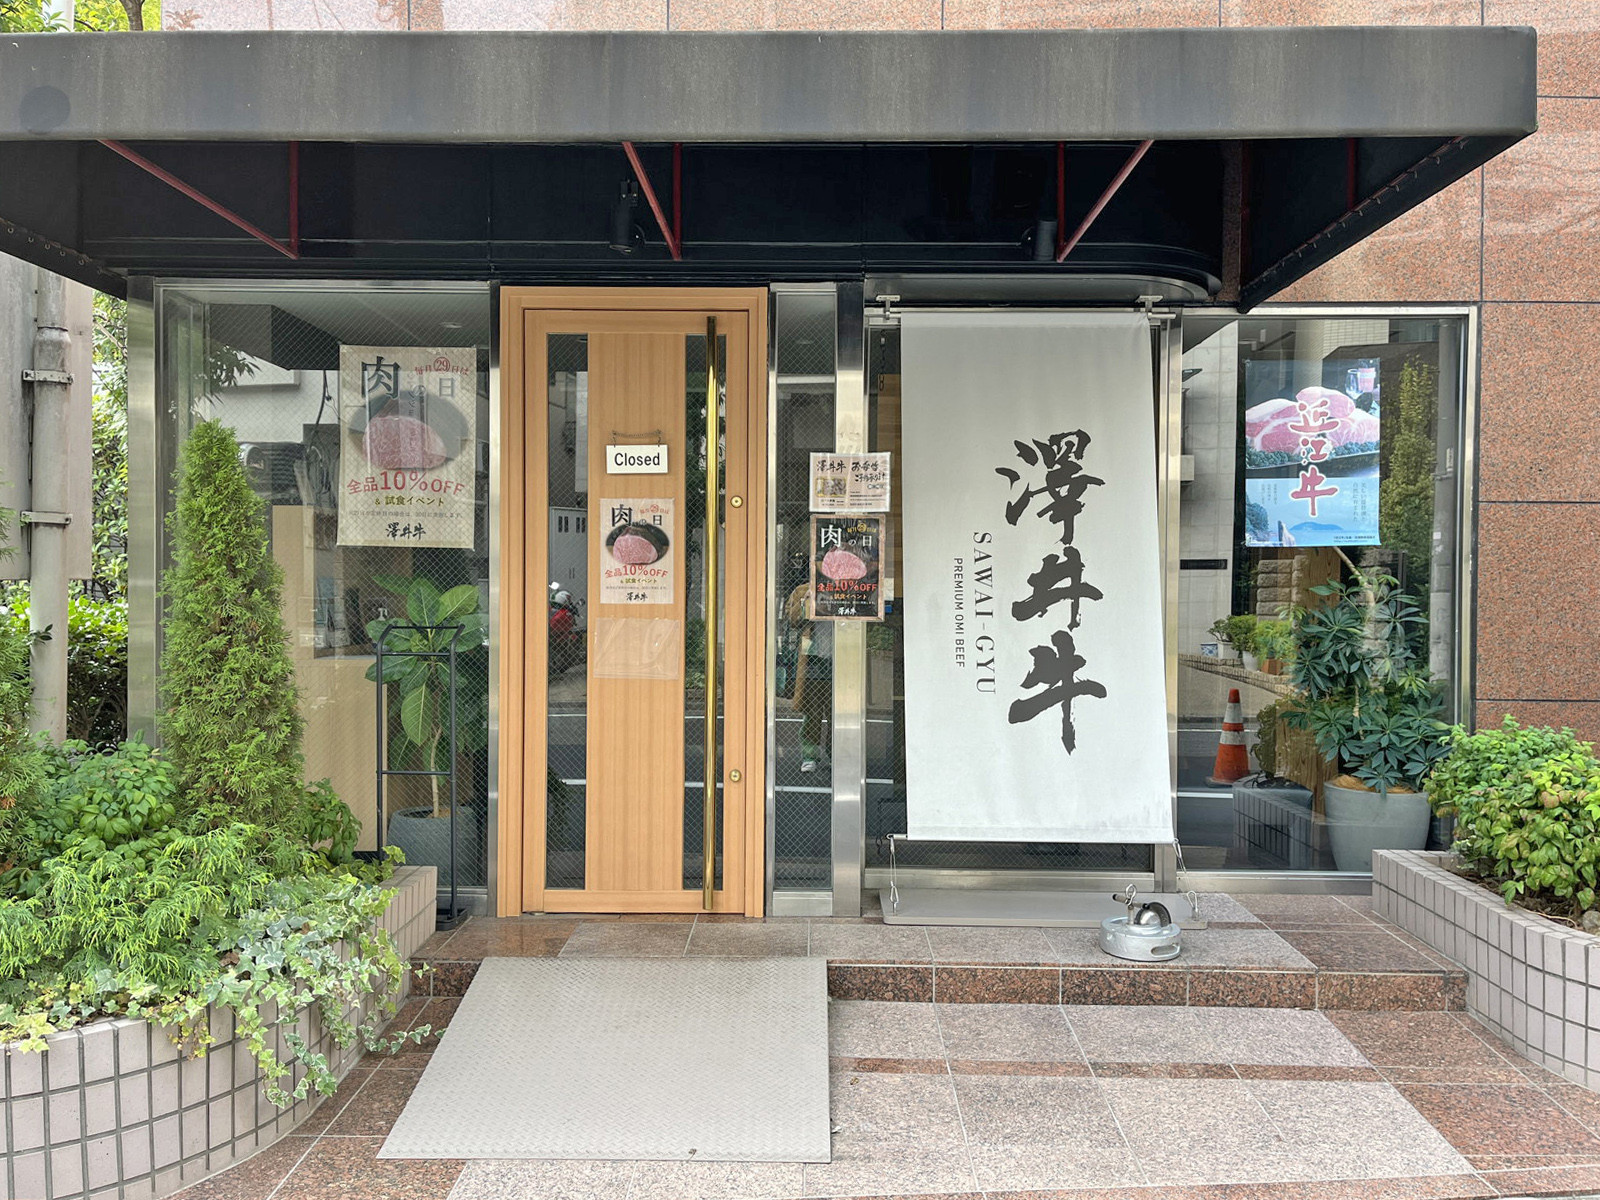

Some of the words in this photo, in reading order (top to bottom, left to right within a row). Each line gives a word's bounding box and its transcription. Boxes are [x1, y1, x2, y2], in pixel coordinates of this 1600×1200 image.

[614, 452, 660, 466] Closed
[1289, 399, 1340, 517] 近江牛
[385, 521, 427, 540] 澤井牛
[953, 557, 965, 611] PREMIUM
[995, 428, 1107, 756] 澤井牛
[954, 614, 964, 635] OMI
[973, 531, 996, 695] SAWAI-GYU
[955, 638, 965, 668] BEEF
